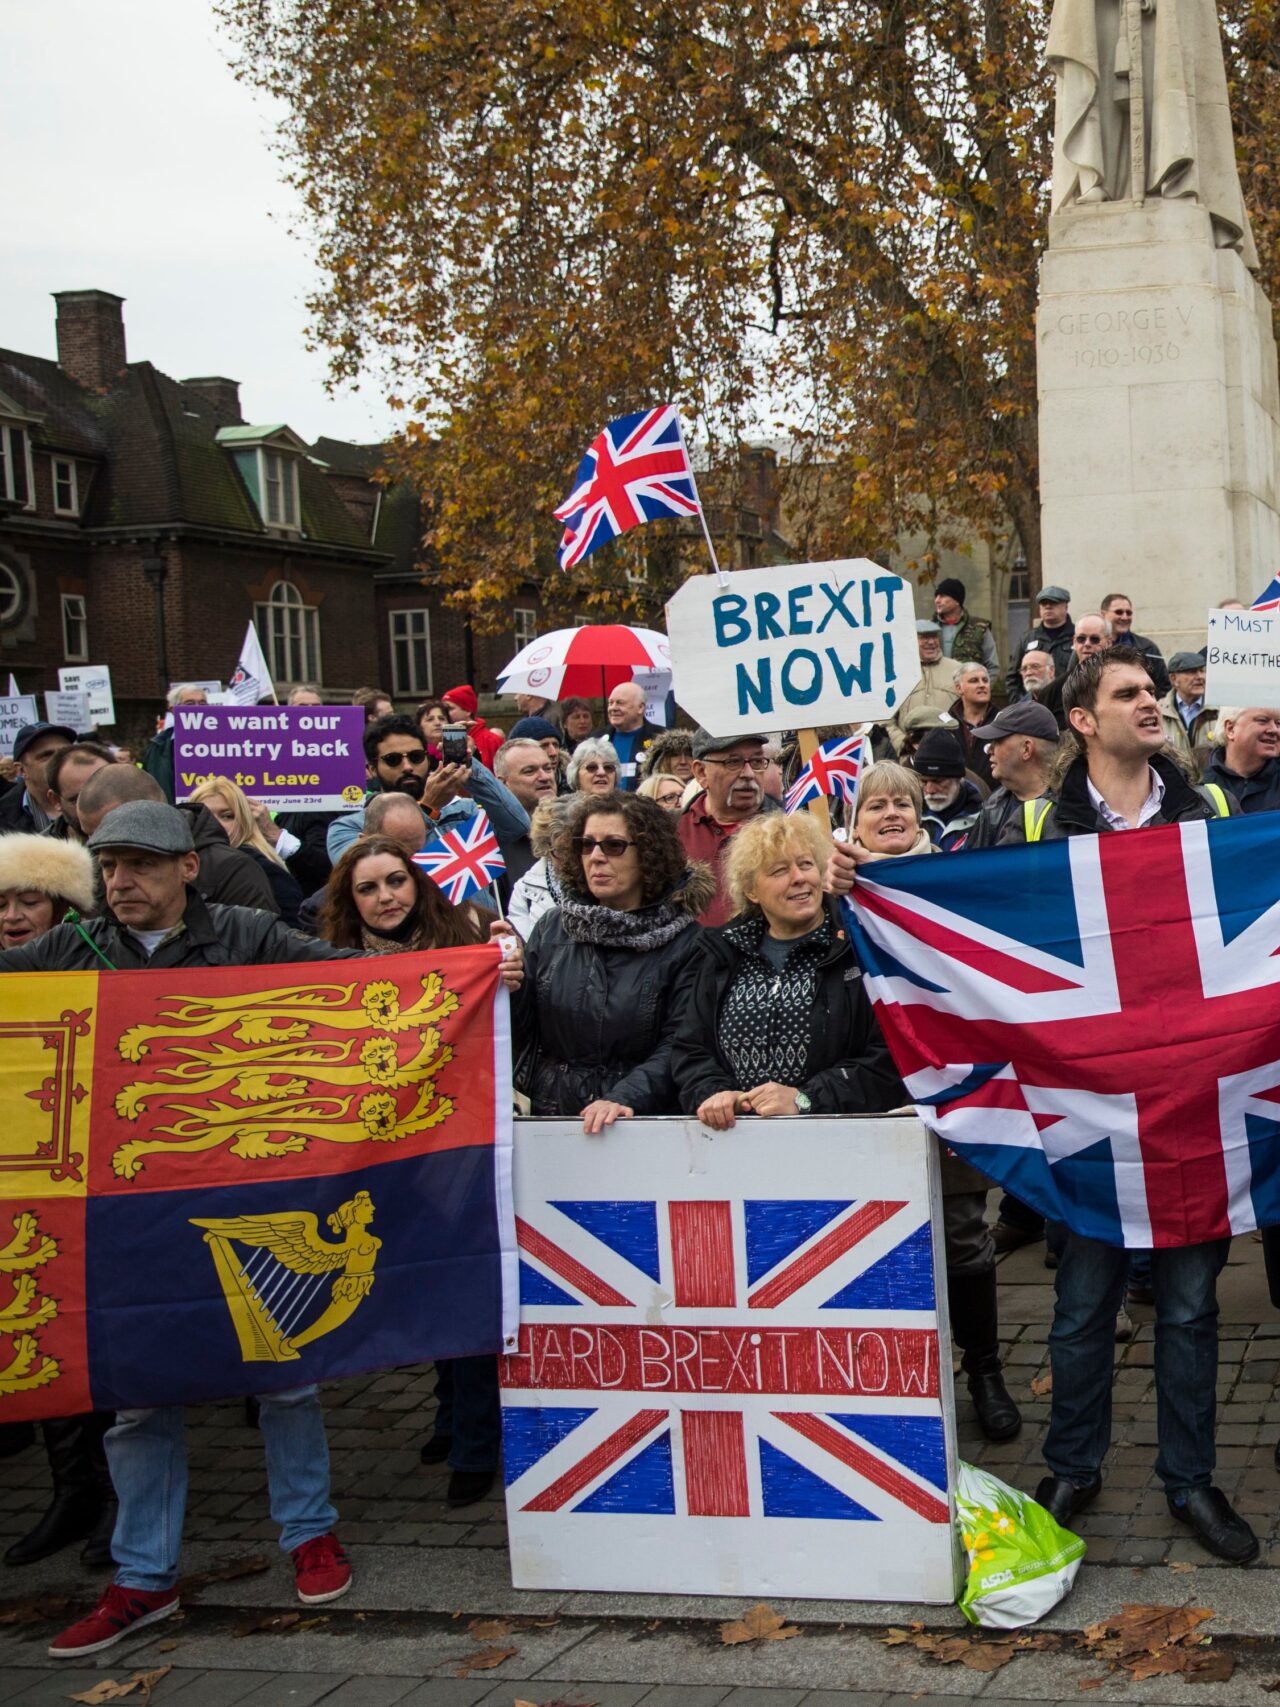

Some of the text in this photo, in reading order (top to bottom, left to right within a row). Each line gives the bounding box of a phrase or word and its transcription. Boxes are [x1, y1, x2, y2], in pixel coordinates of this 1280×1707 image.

[1057, 305, 1194, 336] GEORGE V
[712, 576, 904, 648] BREXIT
[735, 632, 897, 716] NOW!
[179, 712, 341, 730] We want our
[180, 739, 349, 761] country back
[235, 772, 256, 786] to
[263, 772, 320, 786] Leave
[304, 796, 322, 804] 23rd
[816, 1329, 930, 1394] NOW
[981, 1568, 1015, 1590] ASDA
